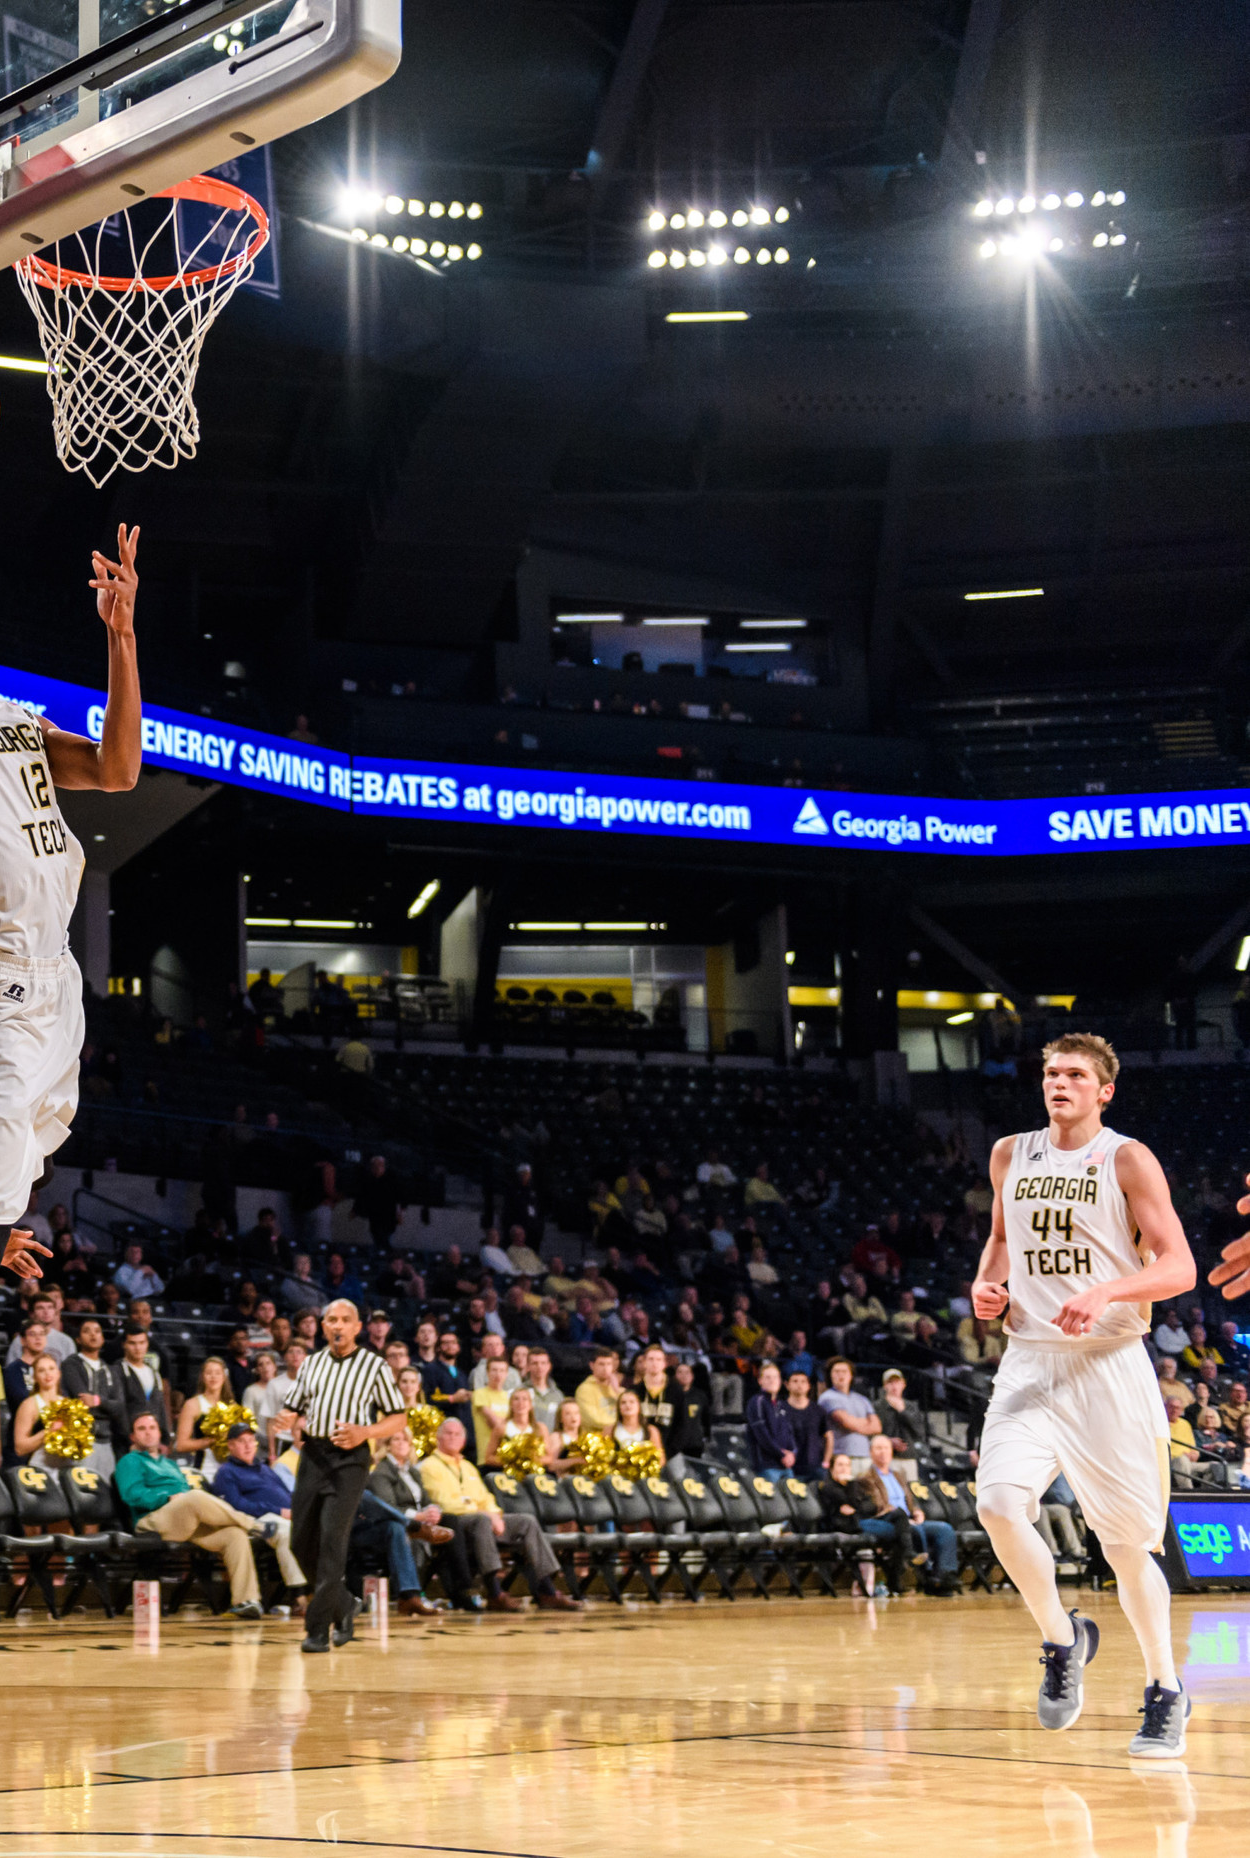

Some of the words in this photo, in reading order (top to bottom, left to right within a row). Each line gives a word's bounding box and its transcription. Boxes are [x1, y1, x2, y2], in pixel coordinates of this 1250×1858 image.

[19, 761, 51, 811] 12
[141, 718, 235, 770] ENERGY
[240, 743, 325, 792] SAVING
[329, 765, 458, 809] REBATES
[464, 784, 491, 811] at
[497, 788, 751, 829] georgiapower.com
[832, 810, 921, 845] Georgia
[925, 817, 997, 844] Power
[1049, 808, 1133, 841] SAVE
[1014, 1175, 1098, 1205] GEORGIA
[1031, 1208, 1074, 1242] 44
[1024, 1247, 1092, 1276] TECH
[1178, 1523, 1234, 1564] sage
[1237, 1524, 1250, 1552] A
